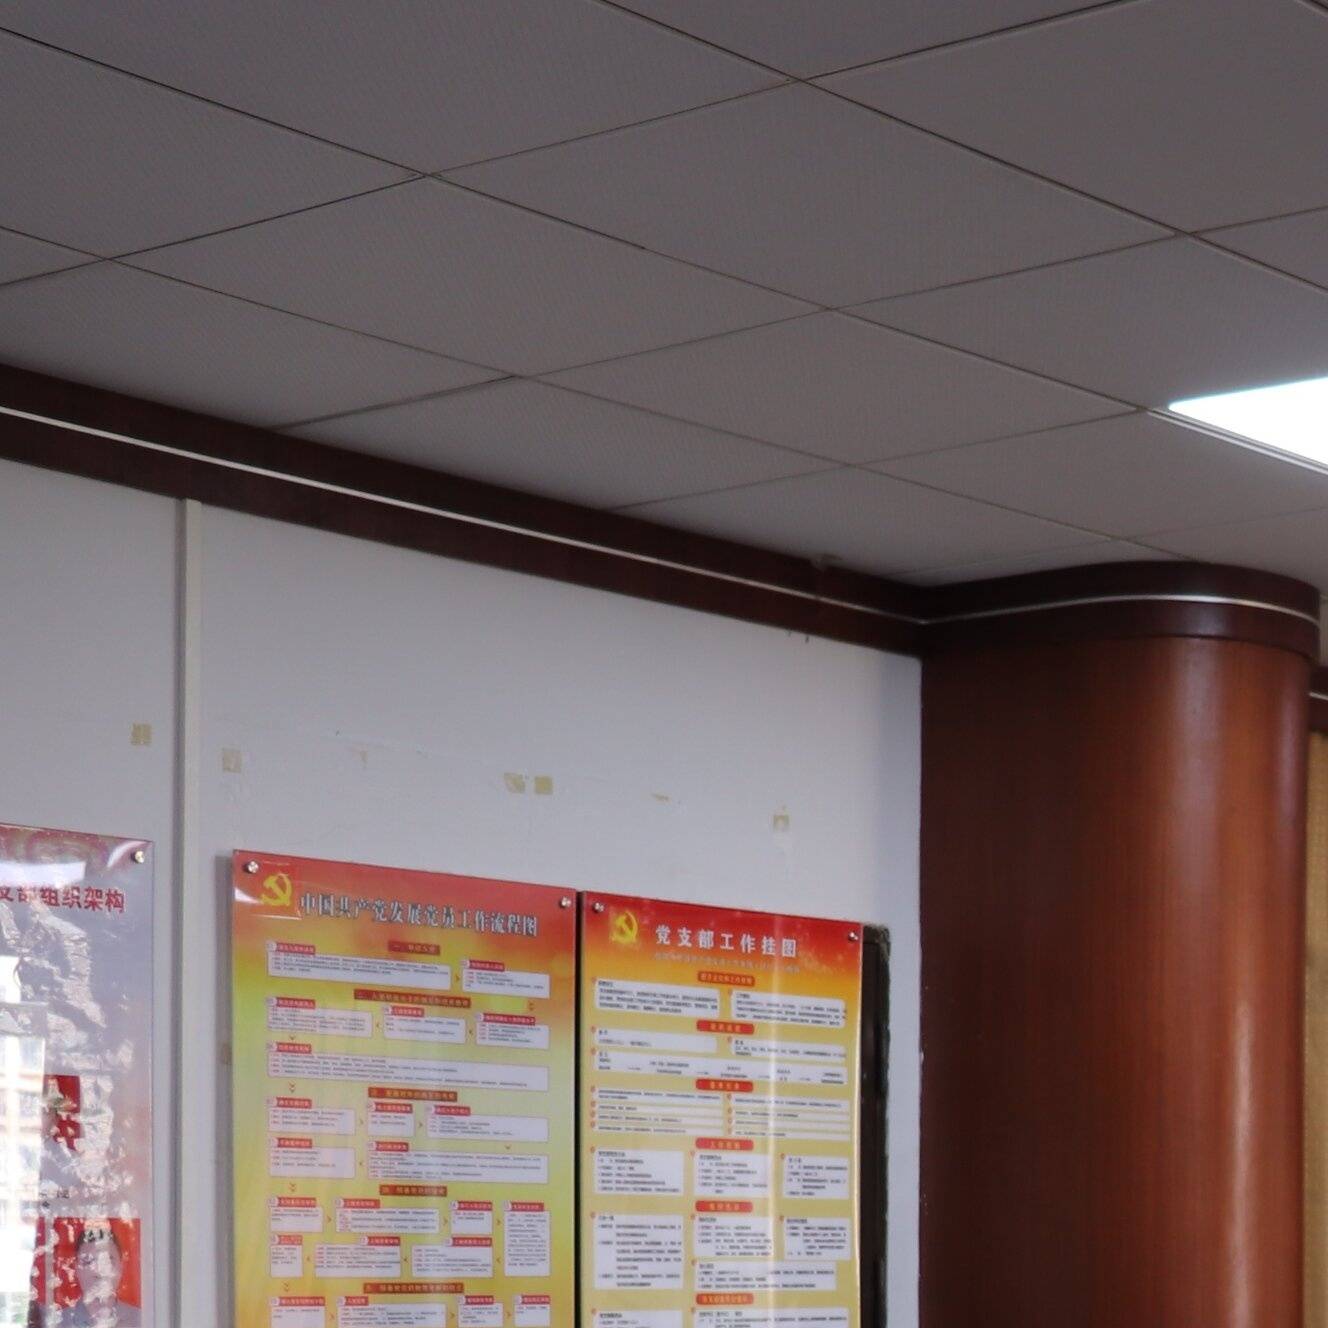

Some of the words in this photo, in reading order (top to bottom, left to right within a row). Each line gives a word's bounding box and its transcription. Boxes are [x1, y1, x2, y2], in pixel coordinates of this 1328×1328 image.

[300, 892, 538, 937] 中国共产党发展党员工作流程图
[655, 924, 797, 958] 党支部工作挂图
